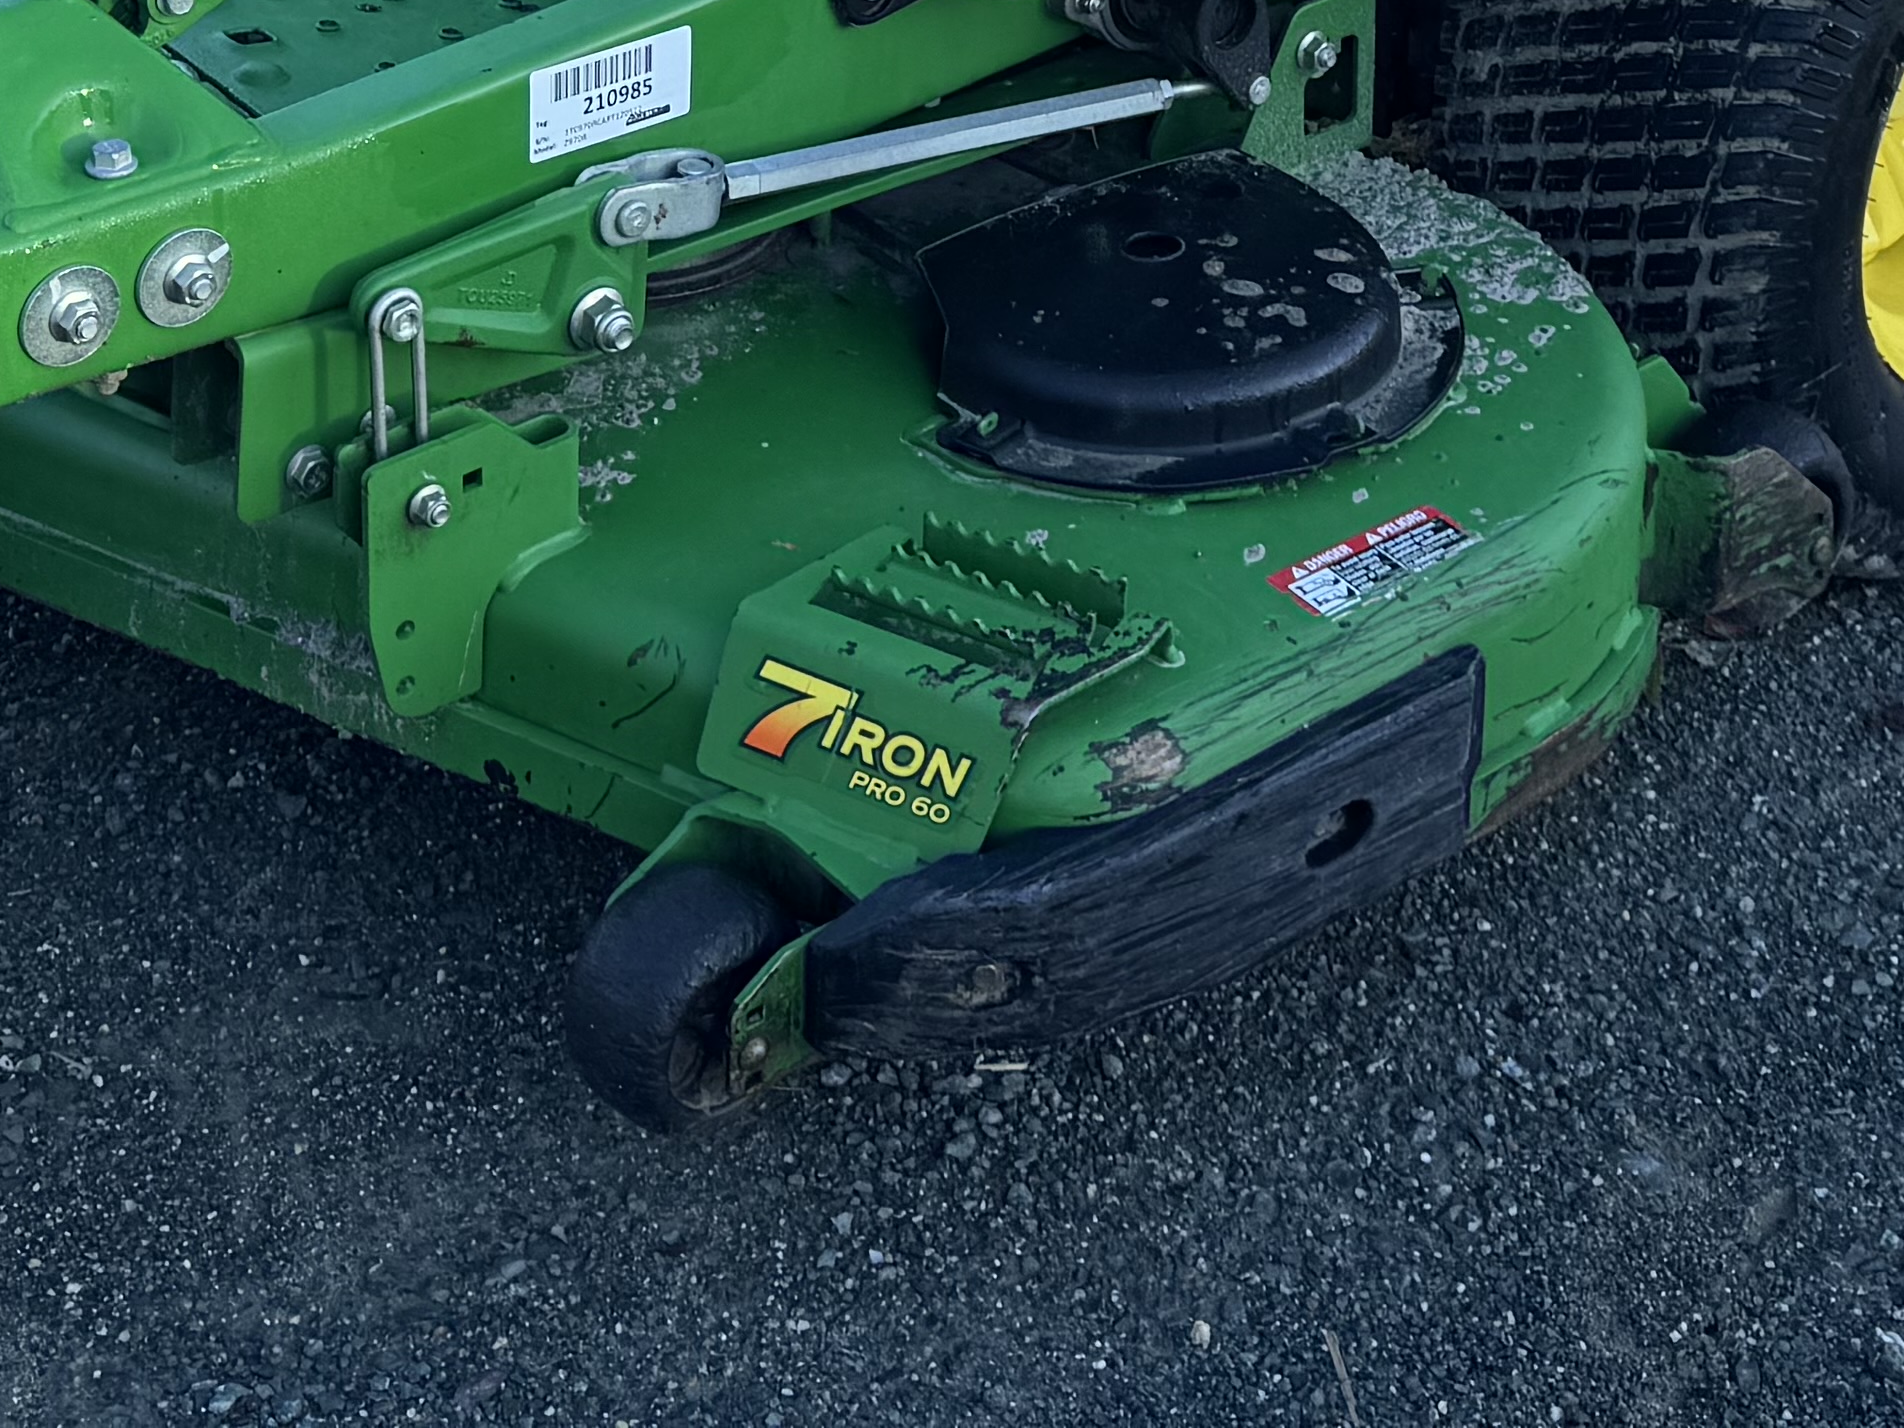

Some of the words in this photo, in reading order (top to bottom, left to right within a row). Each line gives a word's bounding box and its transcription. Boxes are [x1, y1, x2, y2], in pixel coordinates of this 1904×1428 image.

[583, 77, 653, 115] 210985
[1303, 543, 1355, 571] DANGER
[848, 770, 907, 807] PRO
[910, 796, 951, 825] 60
